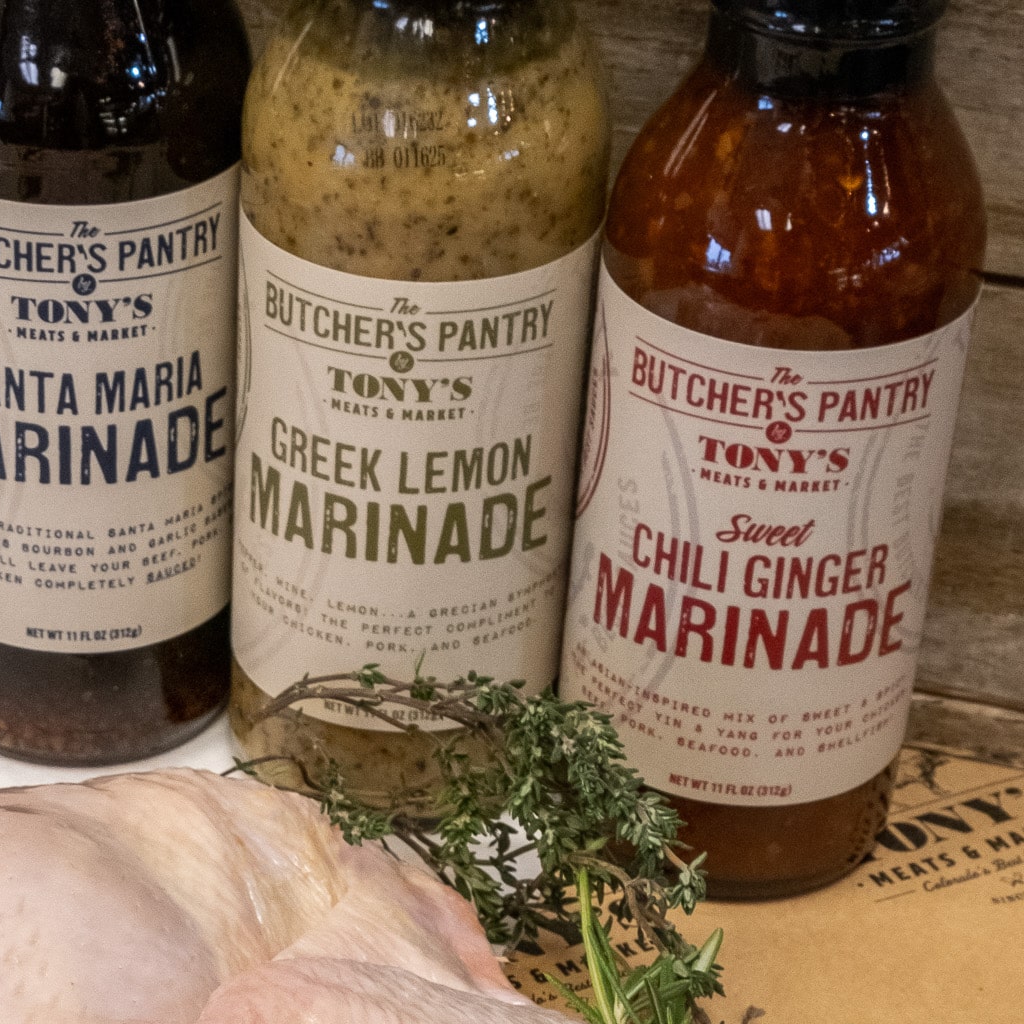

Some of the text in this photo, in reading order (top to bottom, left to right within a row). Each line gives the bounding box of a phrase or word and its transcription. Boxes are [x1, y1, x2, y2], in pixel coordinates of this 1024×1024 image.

[70, 221, 100, 239] The
[119, 212, 221, 271] PANTRY
[11, 293, 153, 324] TONY'S
[265, 280, 555, 352] BUTCHER'S PANTRY
[390, 297, 422, 315] The
[17, 324, 148, 343] MEATS & MARKET
[95, 350, 203, 415] MARIA
[327, 366, 474, 404] TONY'S
[631, 346, 808, 423] BUTCHER'S
[817, 369, 936, 423] PANTRY
[770, 366, 804, 386] The
[331, 398, 466, 422] MEATS & MARKET
[270, 416, 382, 492] GREEK
[398, 434, 532, 494] LEMON
[698, 435, 851, 473] TONY'S
[700, 467, 840, 493] MEATS & MARKET
[108, 521, 156, 540] SANTA
[164, 502, 204, 528] MARIA
[249, 451, 552, 566] MARINADE
[22, 542, 95, 557] BOURBON
[108, 542, 138, 556] AND
[148, 522, 198, 551] GARLIC
[715, 513, 816, 548] Sweet
[28, 560, 78, 575] LEAVE
[91, 559, 131, 573] YOUR
[632, 522, 729, 594] CHILI
[743, 543, 890, 600] GINGER
[34, 575, 135, 591] COMPLETELY
[320, 612, 349, 630] THE
[361, 622, 433, 637] PERFECT
[429, 598, 498, 620] GRECIAN
[593, 552, 912, 671] MARINADE
[26, 626, 43, 640] NET
[47, 628, 63, 641] WT
[67, 631, 78, 642] 11
[80, 630, 92, 642] FL
[93, 628, 107, 641] OZ
[430, 638, 461, 652] AND
[655, 710, 682, 729] YIN
[695, 724, 703, 735] &
[717, 727, 759, 742] YANG
[772, 729, 804, 741] FOR
[815, 719, 853, 738] YOUR
[724, 712, 755, 724] MIX
[768, 711, 790, 724] OF
[802, 702, 851, 723] SWEET
[775, 745, 805, 758] AND
[669, 772, 688, 789] NET
[691, 777, 709, 792] WT
[711, 780, 723, 794] 11
[726, 783, 738, 795] FL
[741, 784, 755, 796] OZ
[868, 846, 981, 888] MEATS &
